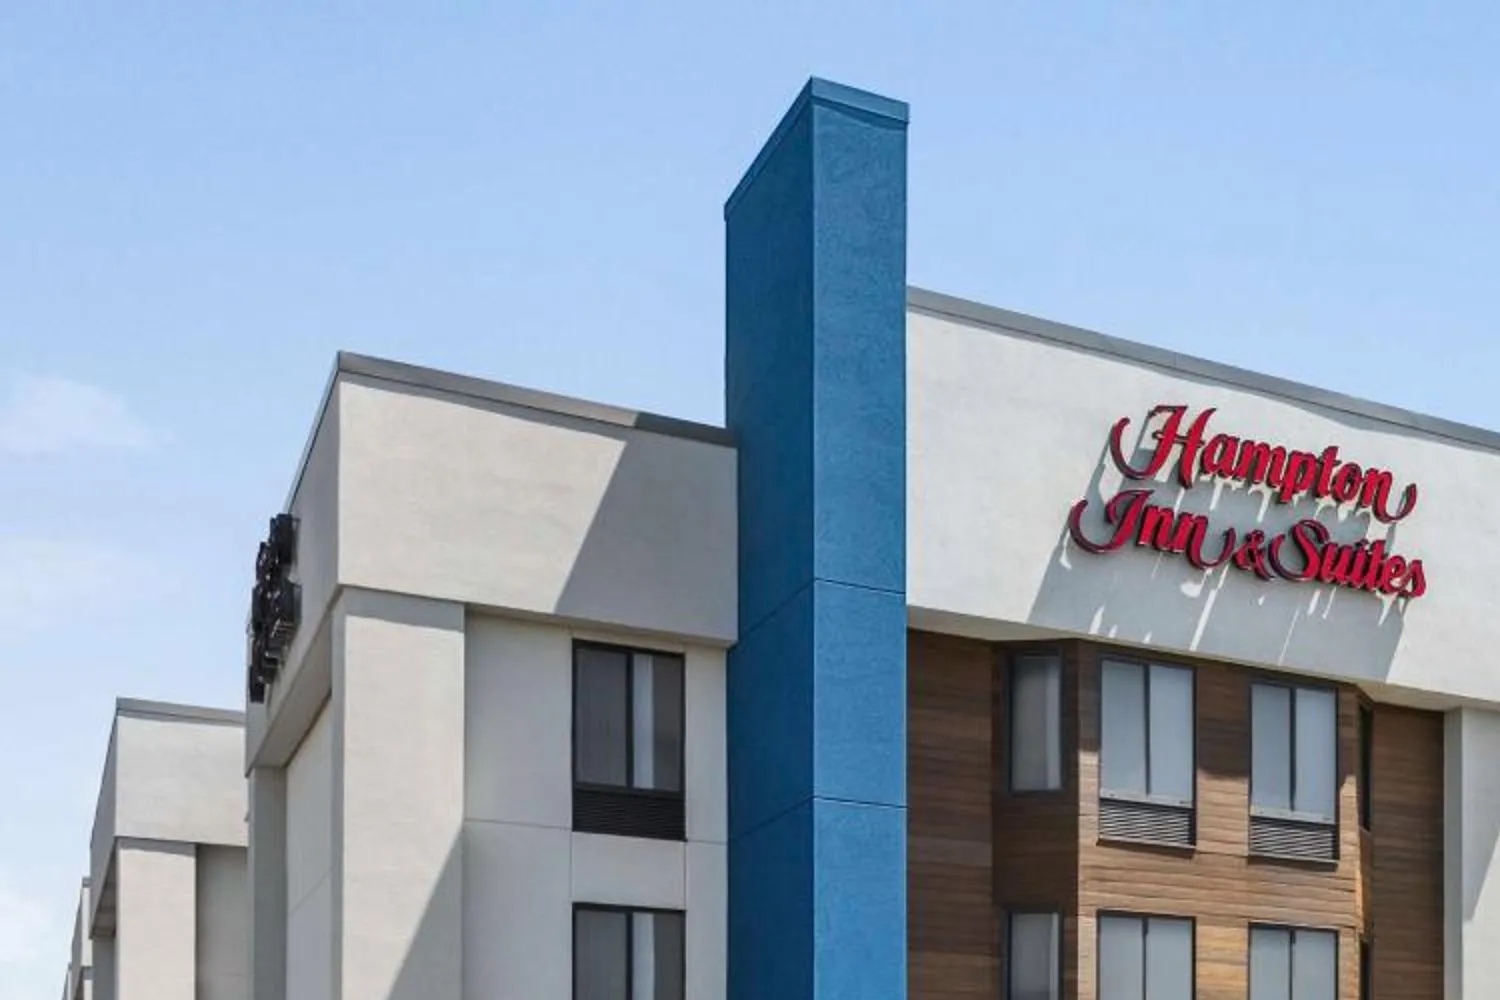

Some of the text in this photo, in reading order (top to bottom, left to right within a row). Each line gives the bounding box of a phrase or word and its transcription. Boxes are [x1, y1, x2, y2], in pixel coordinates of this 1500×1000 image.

[1110, 405, 1417, 524] Hampton
[1069, 490, 1428, 598] Inn & Suites
